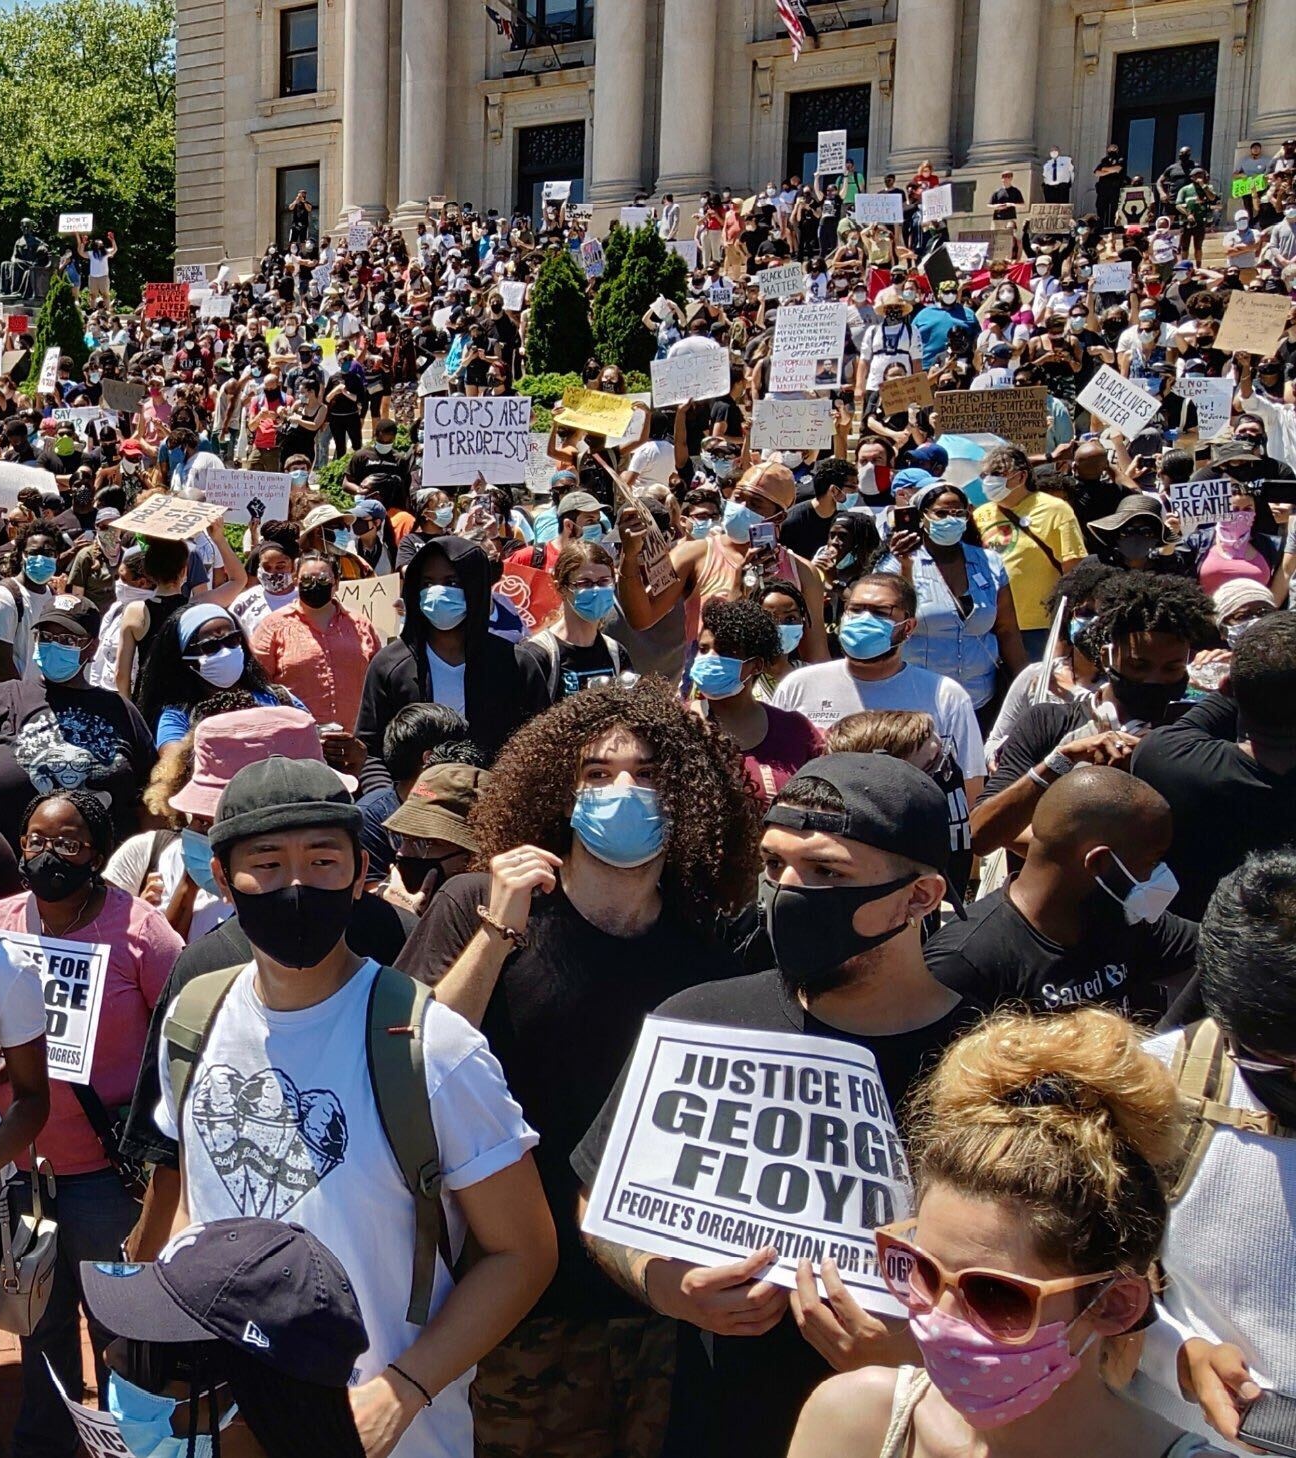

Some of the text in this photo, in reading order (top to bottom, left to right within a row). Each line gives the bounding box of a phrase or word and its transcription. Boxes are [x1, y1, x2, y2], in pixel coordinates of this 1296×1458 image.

[761, 265, 801, 283] BLACK LIVES
[156, 295, 186, 303] BLACK
[763, 280, 800, 295] MATTER
[155, 310, 190, 319] MATTER
[941, 395, 959, 404] THE
[960, 392, 985, 403] FIRST
[987, 389, 1020, 400] MODERN
[1095, 371, 1127, 401] BLACK
[54, 409, 72, 420] SAY
[434, 399, 529, 428] COPS ARE
[940, 404, 970, 415] POLICE
[970, 402, 998, 413] WERE
[1002, 400, 1023, 411] STATE
[1091, 392, 1131, 427] MATTER
[429, 430, 529, 462] TERRORISTS
[1175, 485, 1188, 500] I
[1171, 495, 1234, 518] BREATHE
[48, 955, 90, 981] FOR
[1041, 970, 1103, 1009] Saved
[674, 1052, 842, 1110] JUSTICE
[214, 1149, 239, 1169] Boys
[286, 1171, 309, 1187] Club
[671, 1142, 895, 1231] FLOYD
[616, 1188, 864, 1273] PEOPLE'S ORGANIZATION FOR
